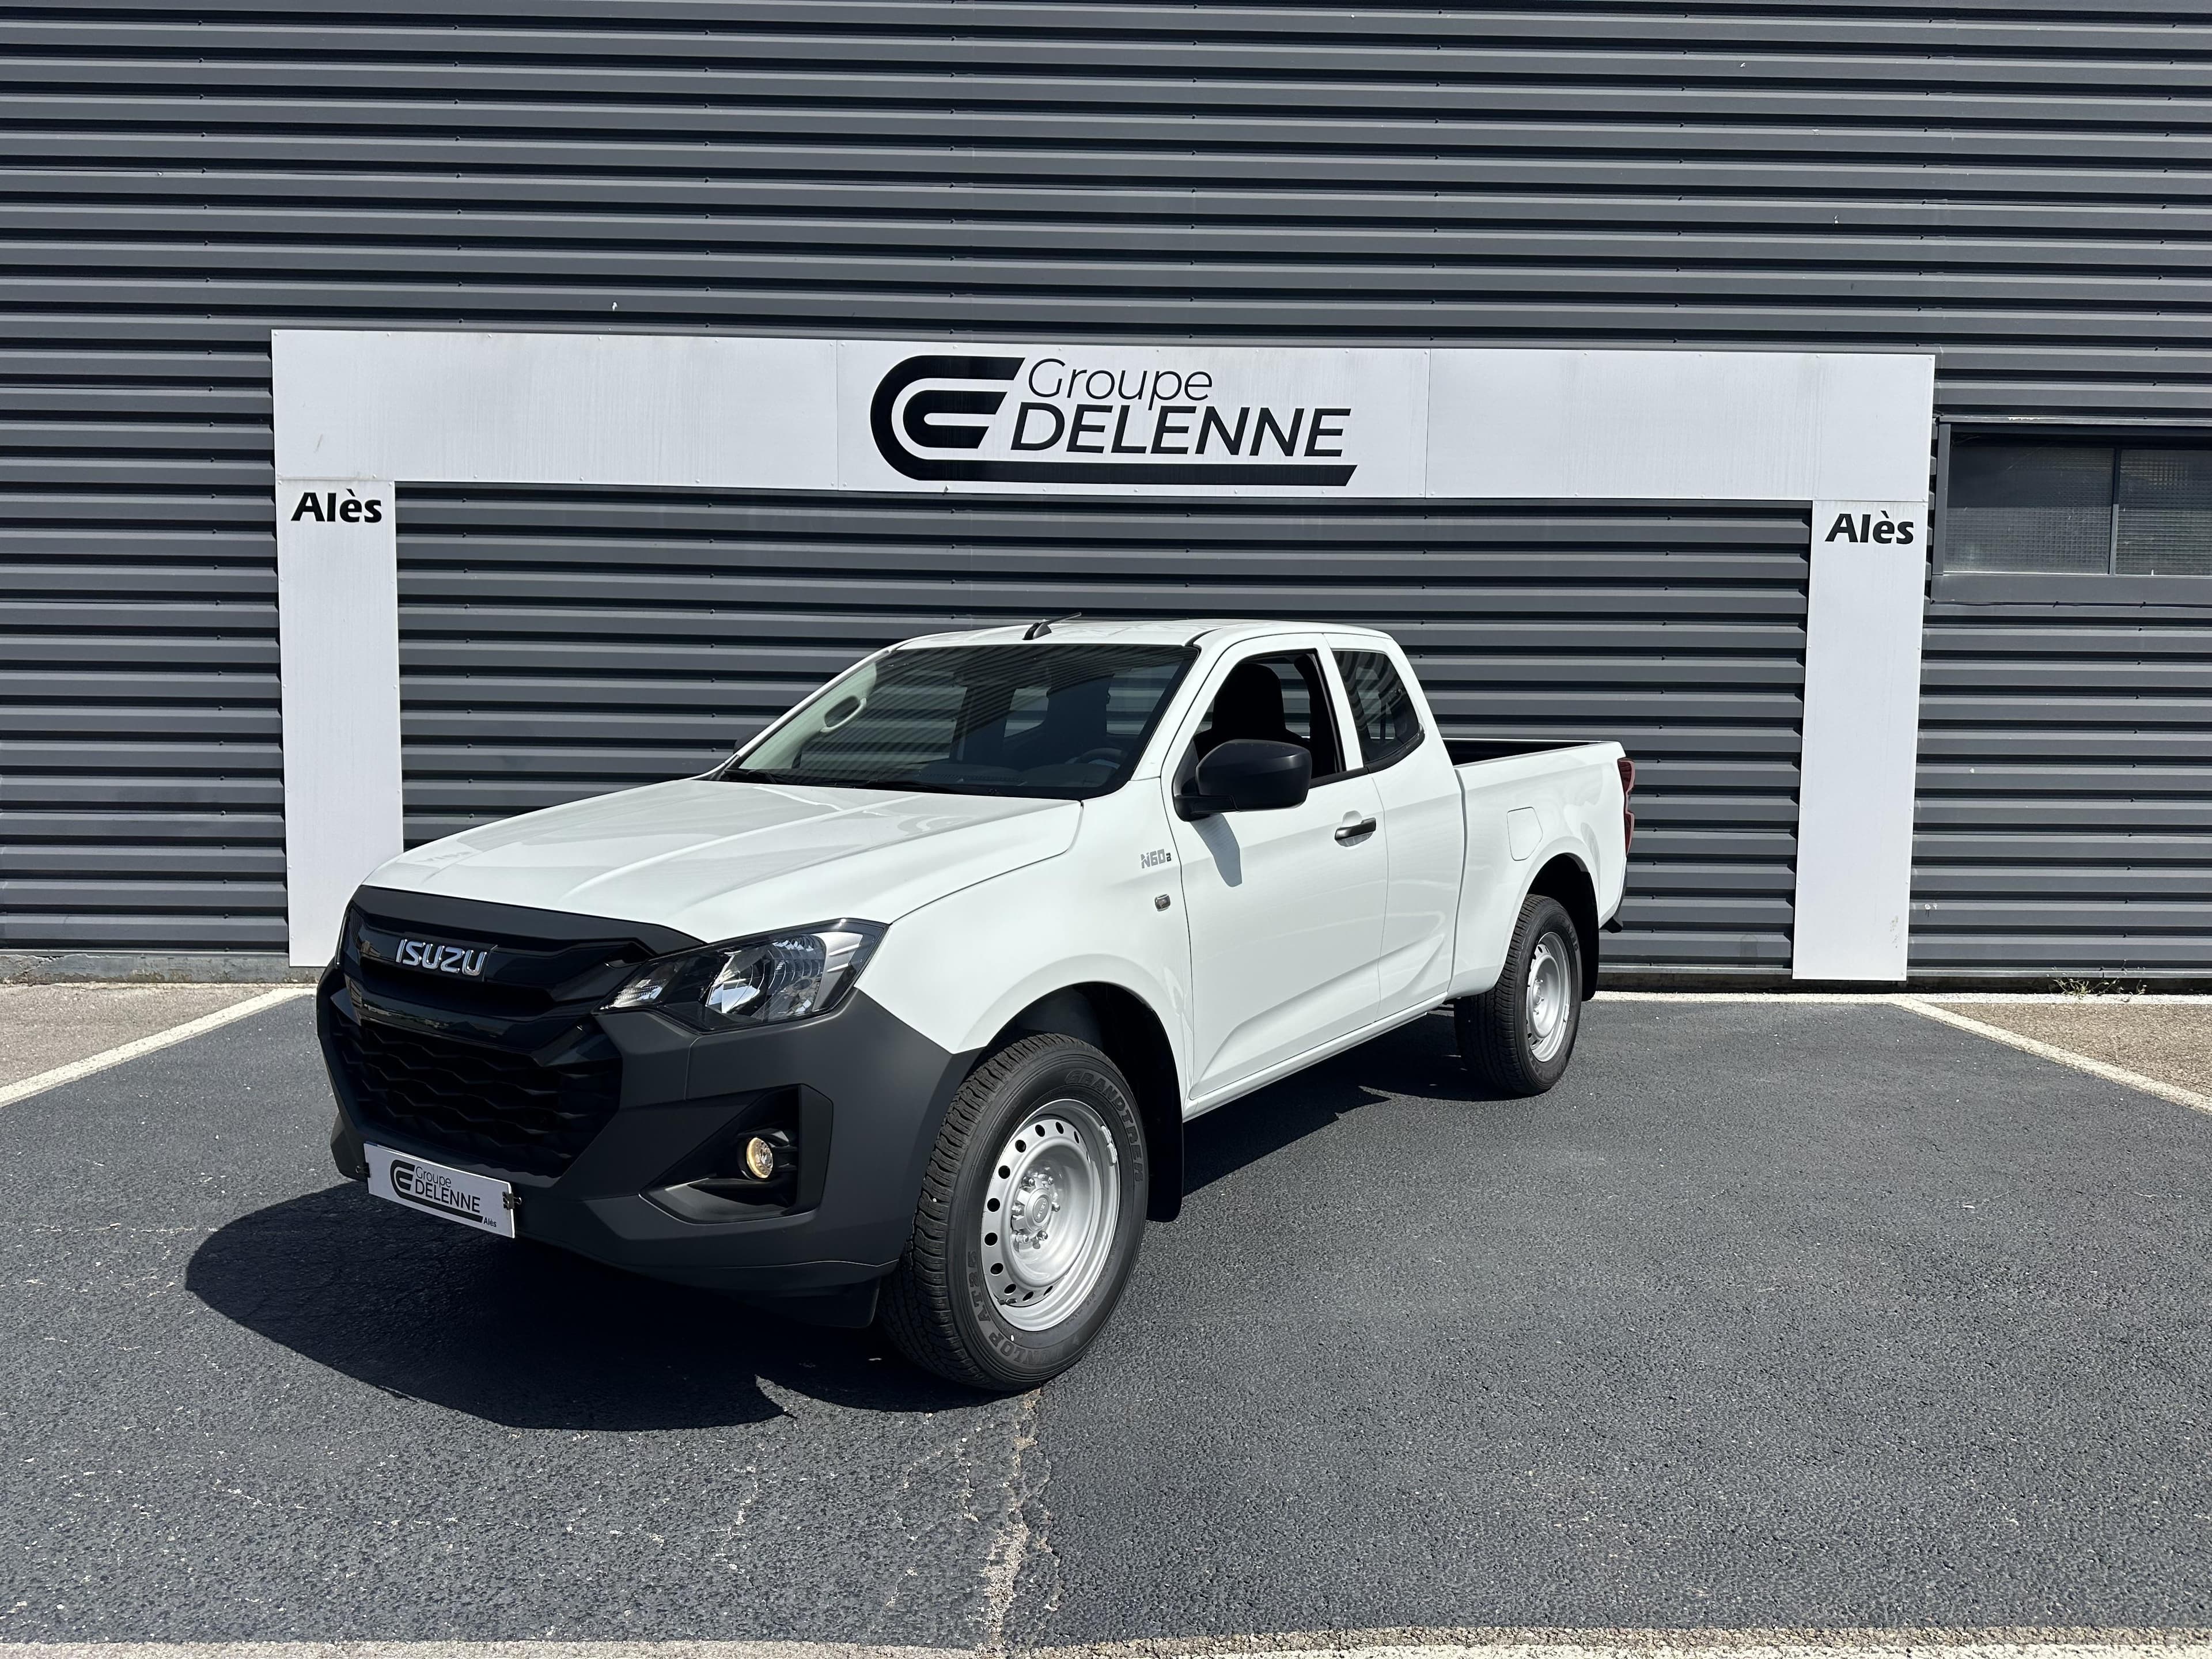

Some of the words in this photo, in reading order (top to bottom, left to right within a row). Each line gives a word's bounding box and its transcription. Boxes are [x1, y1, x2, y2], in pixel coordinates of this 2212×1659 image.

[1028, 357, 1213, 411] Groupe
[1010, 402, 1351, 457] DELENNE
[291, 488, 382, 523] Alès
[1825, 510, 1914, 544] Alès
[396, 940, 487, 976] ISUZU
[1065, 1070, 1144, 1182] GRANDTREK
[415, 1166, 452, 1188] Groupe
[415, 1179, 480, 1213] DELENNE
[484, 1217, 497, 1228] Alès
